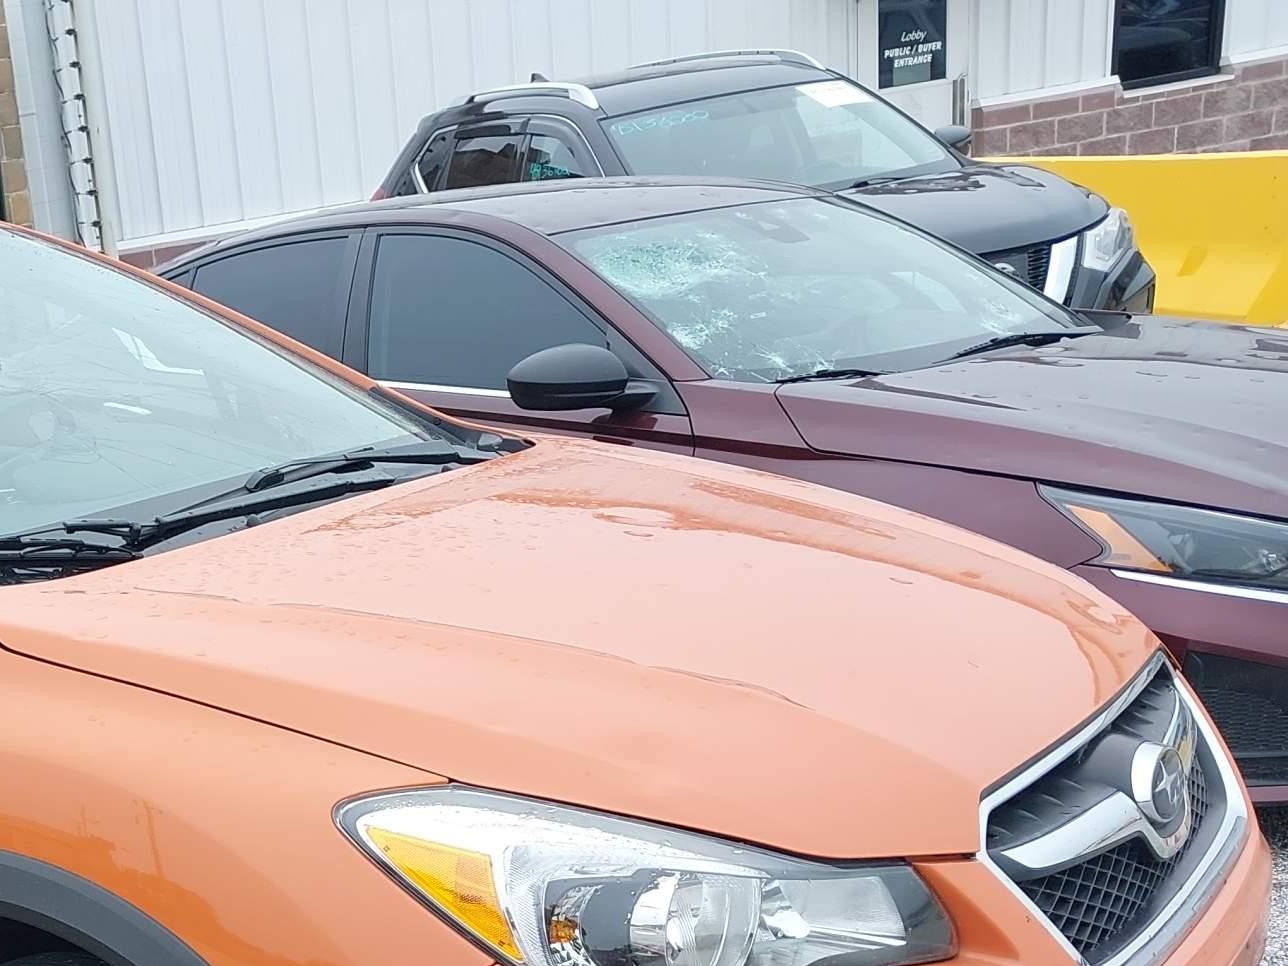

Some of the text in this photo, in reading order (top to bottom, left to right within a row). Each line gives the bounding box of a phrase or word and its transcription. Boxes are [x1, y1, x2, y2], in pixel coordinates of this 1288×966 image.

[901, 29, 927, 42] Lobby
[884, 46, 911, 59] PUBLIC
[918, 41, 942, 53] BUYER
[894, 54, 932, 68] ENTRANCE
